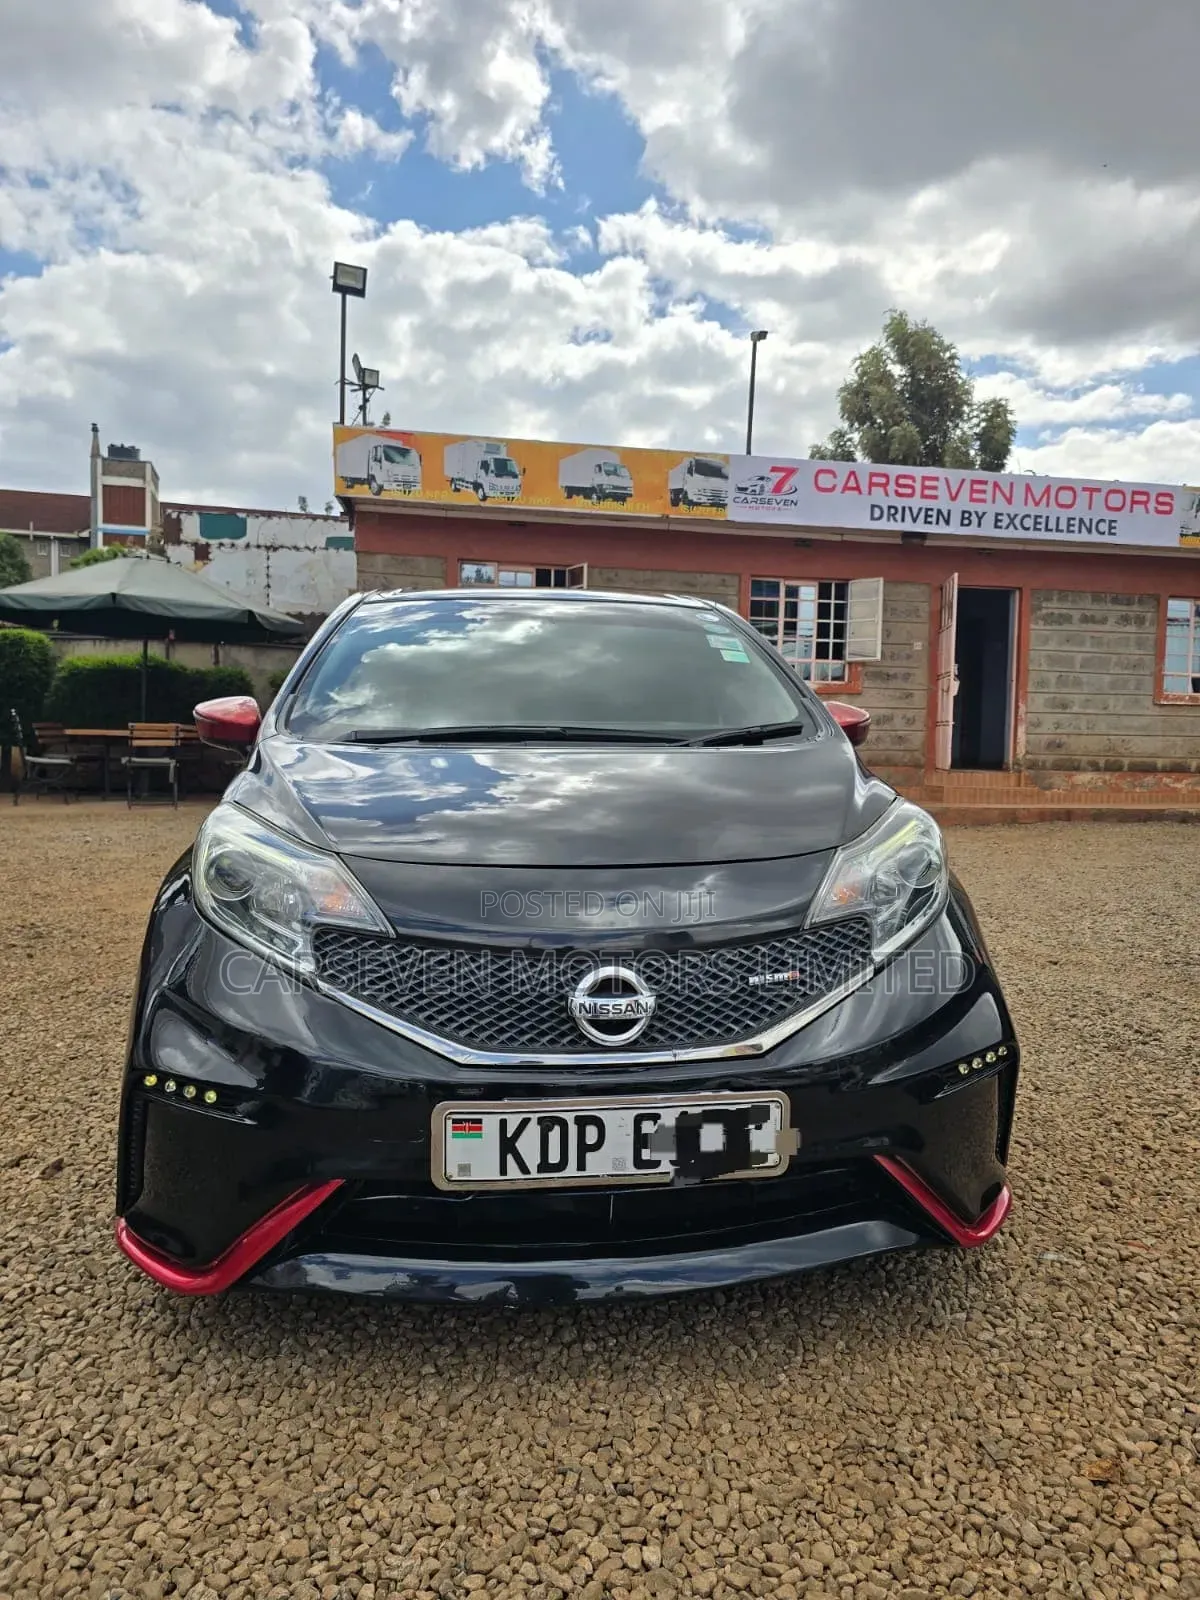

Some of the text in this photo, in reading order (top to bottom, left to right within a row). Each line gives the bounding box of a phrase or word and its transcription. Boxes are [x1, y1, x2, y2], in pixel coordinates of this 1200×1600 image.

[732, 496, 799, 507] CARSEVEN
[813, 467, 1175, 516] CARSEVEN MOTORS
[869, 503, 1118, 537] DRIVEN BY EXCELLENCE
[578, 1001, 649, 1015] NISSAN
[499, 1115, 606, 1177] KDP
